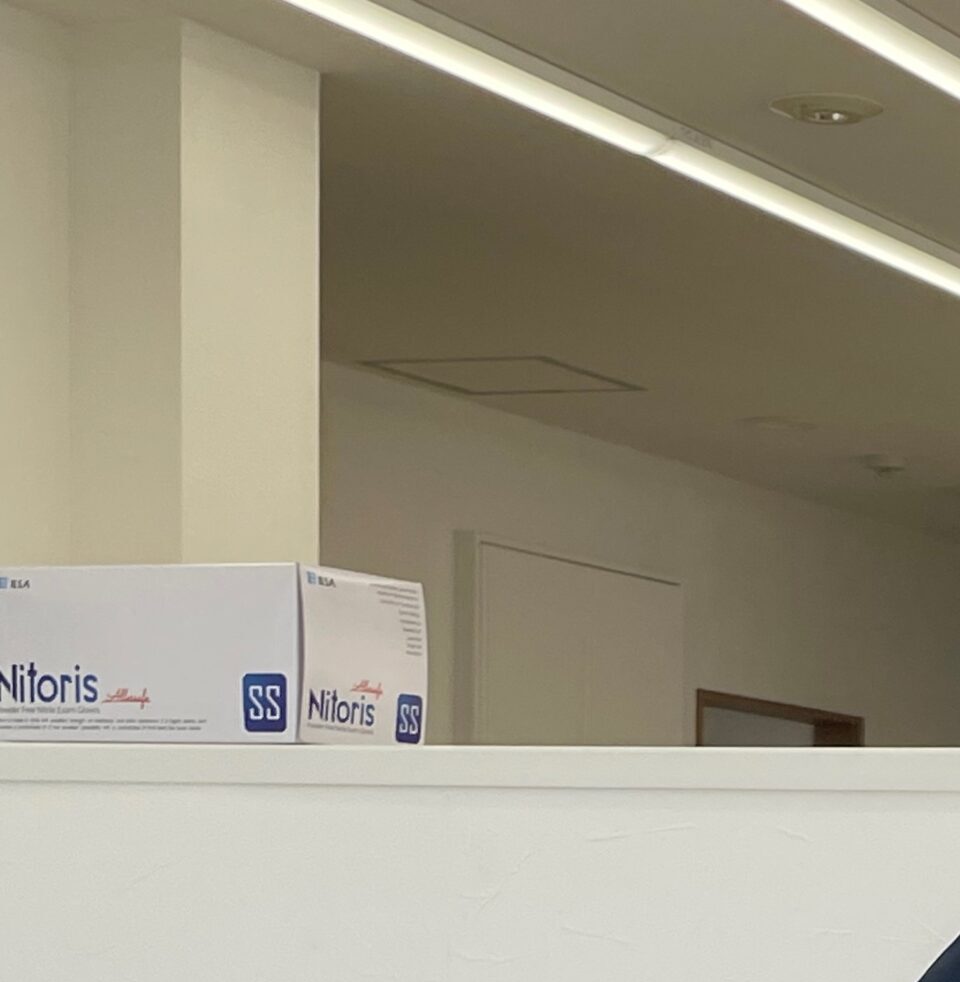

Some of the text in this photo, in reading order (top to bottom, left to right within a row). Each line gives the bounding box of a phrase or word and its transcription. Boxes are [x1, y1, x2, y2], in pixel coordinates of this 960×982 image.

[0, 662, 99, 704] Nitoris
[248, 685, 281, 721] SS
[307, 688, 376, 728] Nitoris
[398, 703, 420, 735] SS
